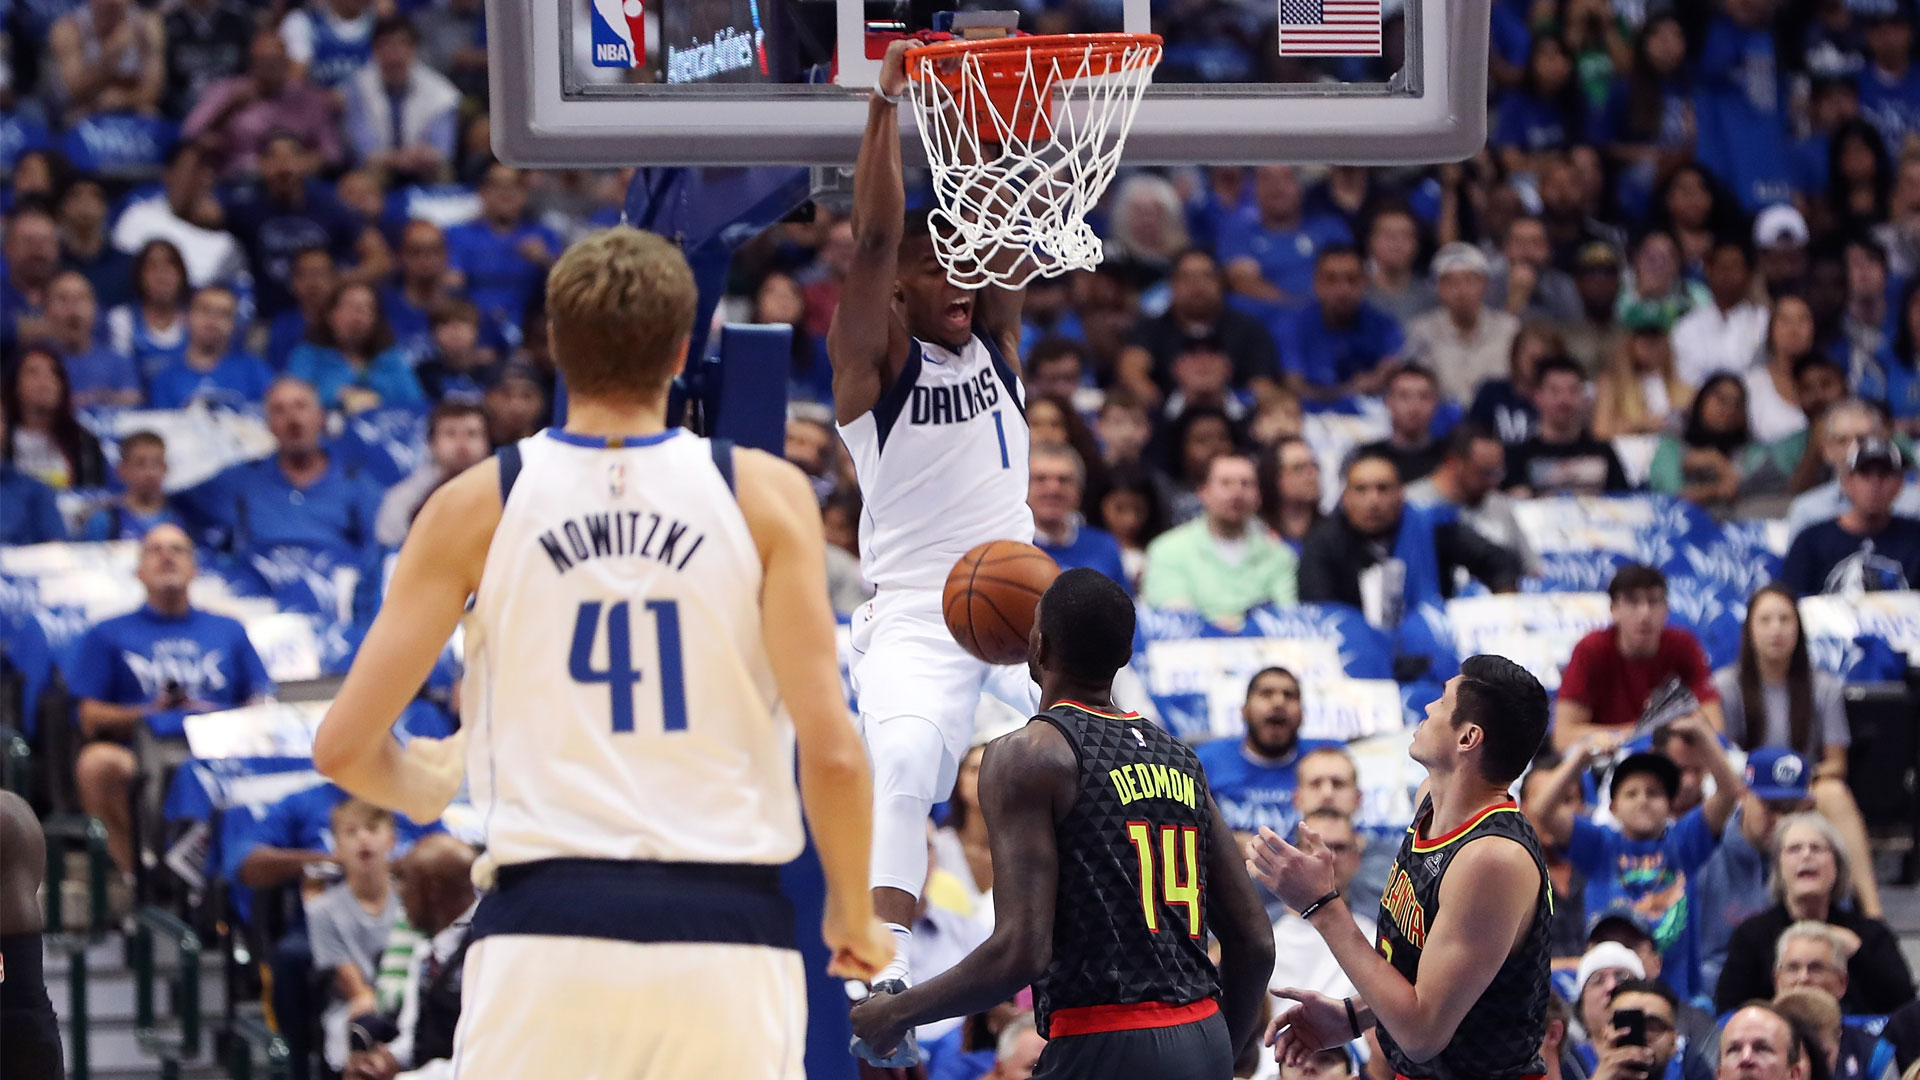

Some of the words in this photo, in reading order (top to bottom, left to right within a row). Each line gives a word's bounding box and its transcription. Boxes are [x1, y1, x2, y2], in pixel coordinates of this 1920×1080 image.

[597, 44, 628, 62] NBA
[911, 366, 998, 426] DALLAS
[992, 410, 1010, 469] 1
[538, 511, 705, 575] NOWITZKI
[568, 599, 688, 733] 41
[1109, 763, 1196, 810] DEDMON
[1126, 820, 1203, 939] 14
[1381, 858, 1426, 951] LANTA
